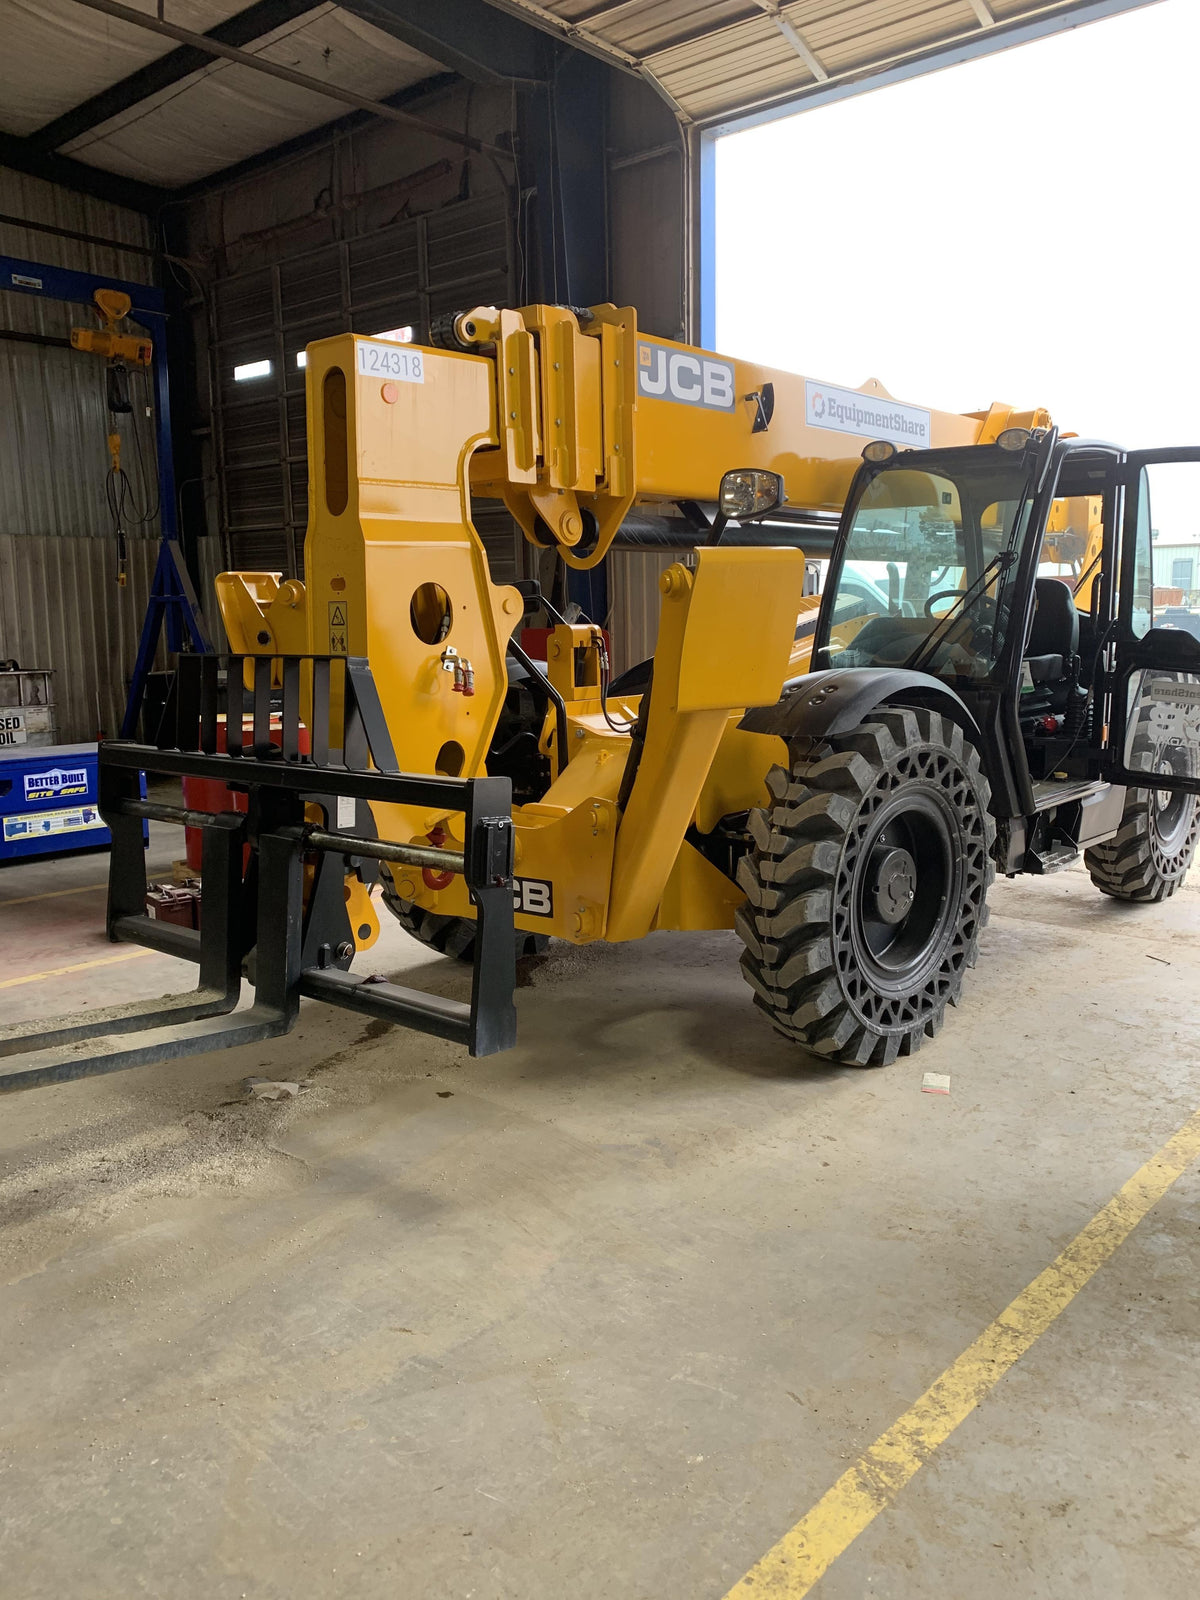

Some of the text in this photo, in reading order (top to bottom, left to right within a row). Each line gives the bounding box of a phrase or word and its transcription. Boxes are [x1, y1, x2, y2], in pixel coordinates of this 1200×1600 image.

[359, 347, 421, 377] 124318
[640, 350, 733, 408] JCB
[828, 398, 926, 437] EquipmentShare
[27, 773, 85, 788] BETTER BUILT
[27, 786, 86, 799] SITE SAFE
